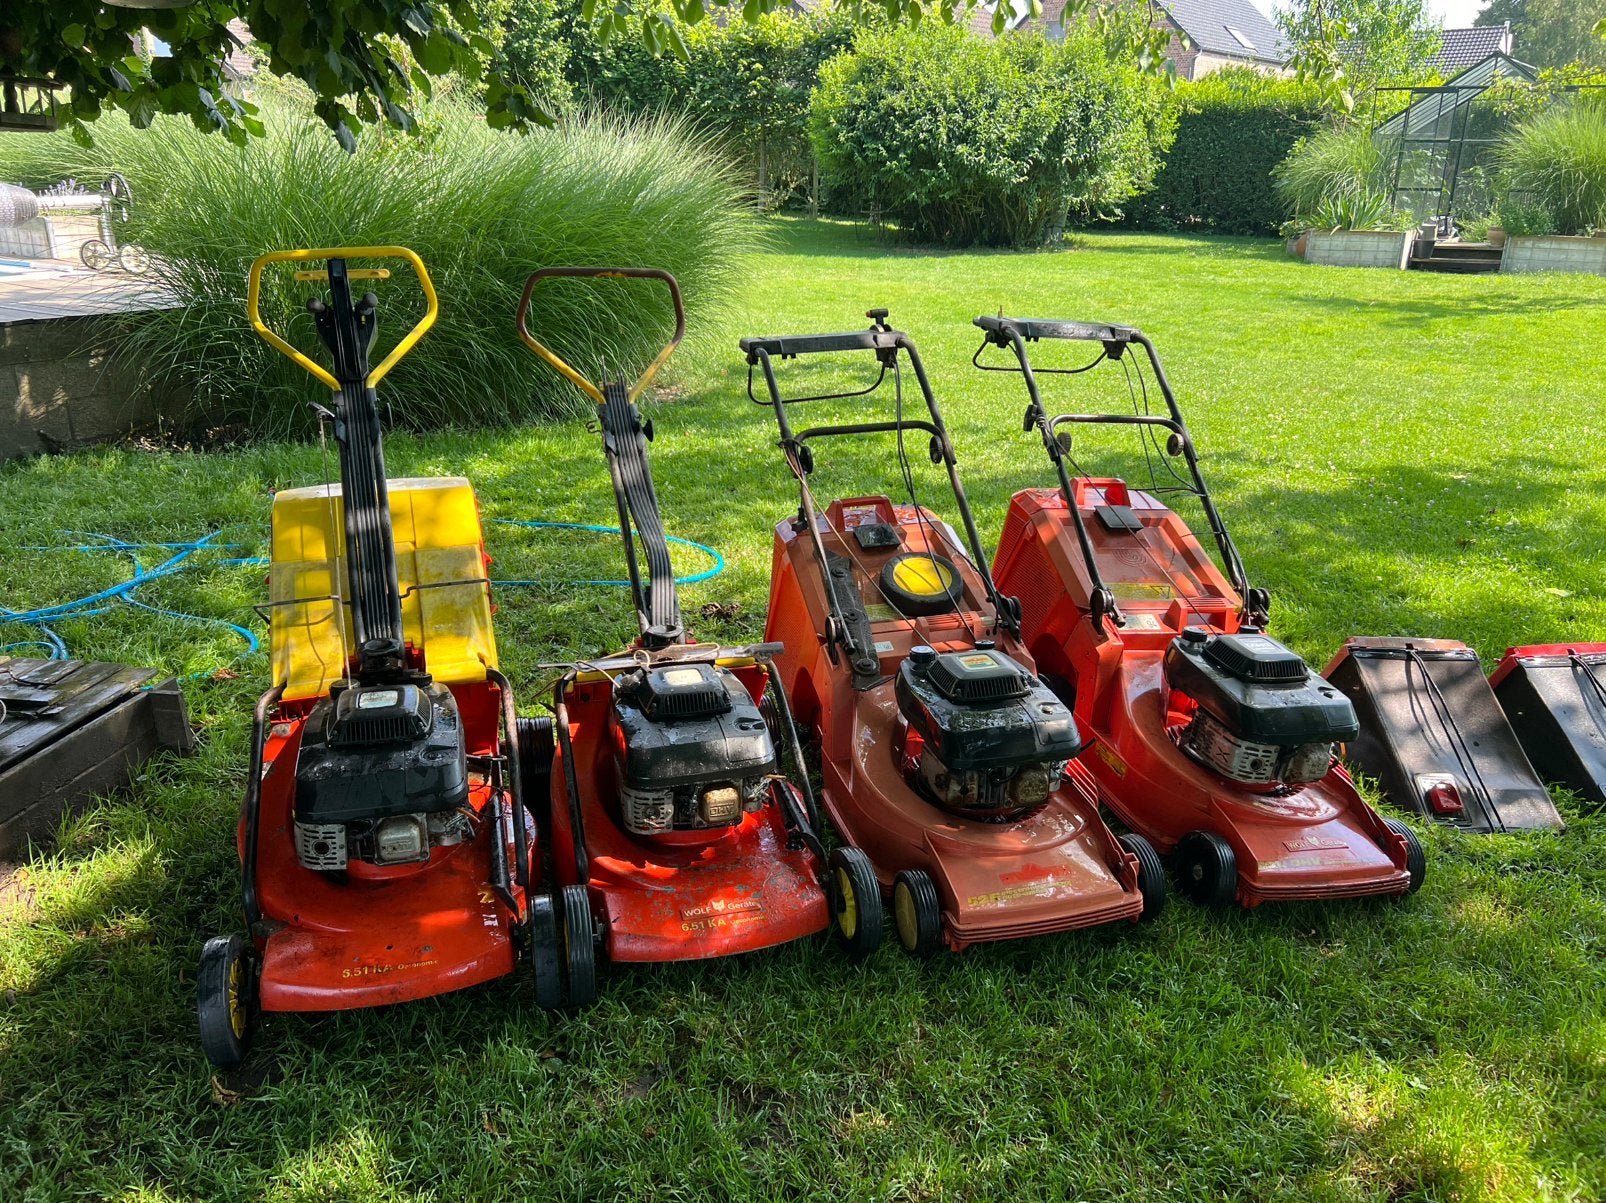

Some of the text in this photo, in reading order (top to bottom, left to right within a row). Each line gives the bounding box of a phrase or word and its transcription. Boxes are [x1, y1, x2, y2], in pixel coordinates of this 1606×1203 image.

[684, 906, 712, 917] WOLF
[681, 921, 705, 932] 6.51
[707, 918, 727, 928] KA
